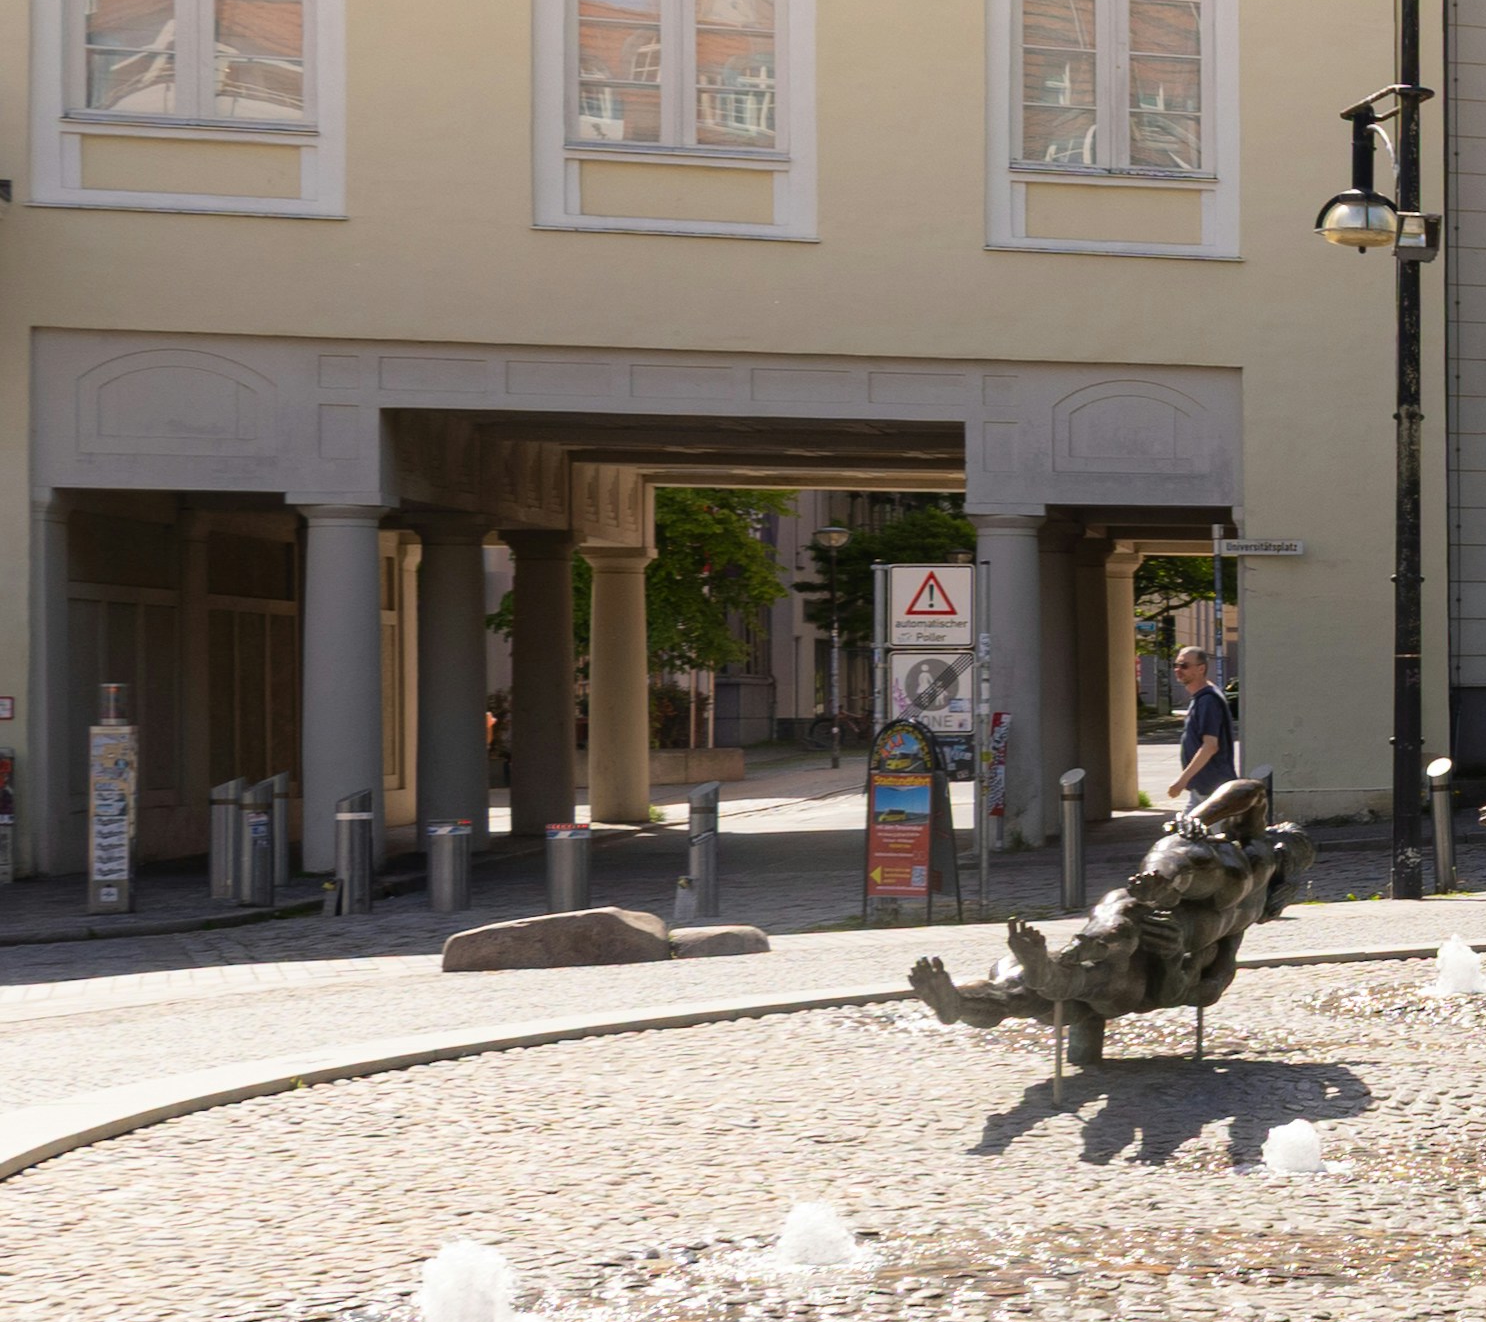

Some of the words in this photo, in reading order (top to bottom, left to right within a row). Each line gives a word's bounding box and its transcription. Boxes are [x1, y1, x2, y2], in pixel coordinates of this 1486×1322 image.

[1225, 541, 1299, 554] Universitätsplatz
[895, 618, 969, 629] automatischer
[915, 631, 947, 643] Poller
[911, 714, 953, 727] ONE
